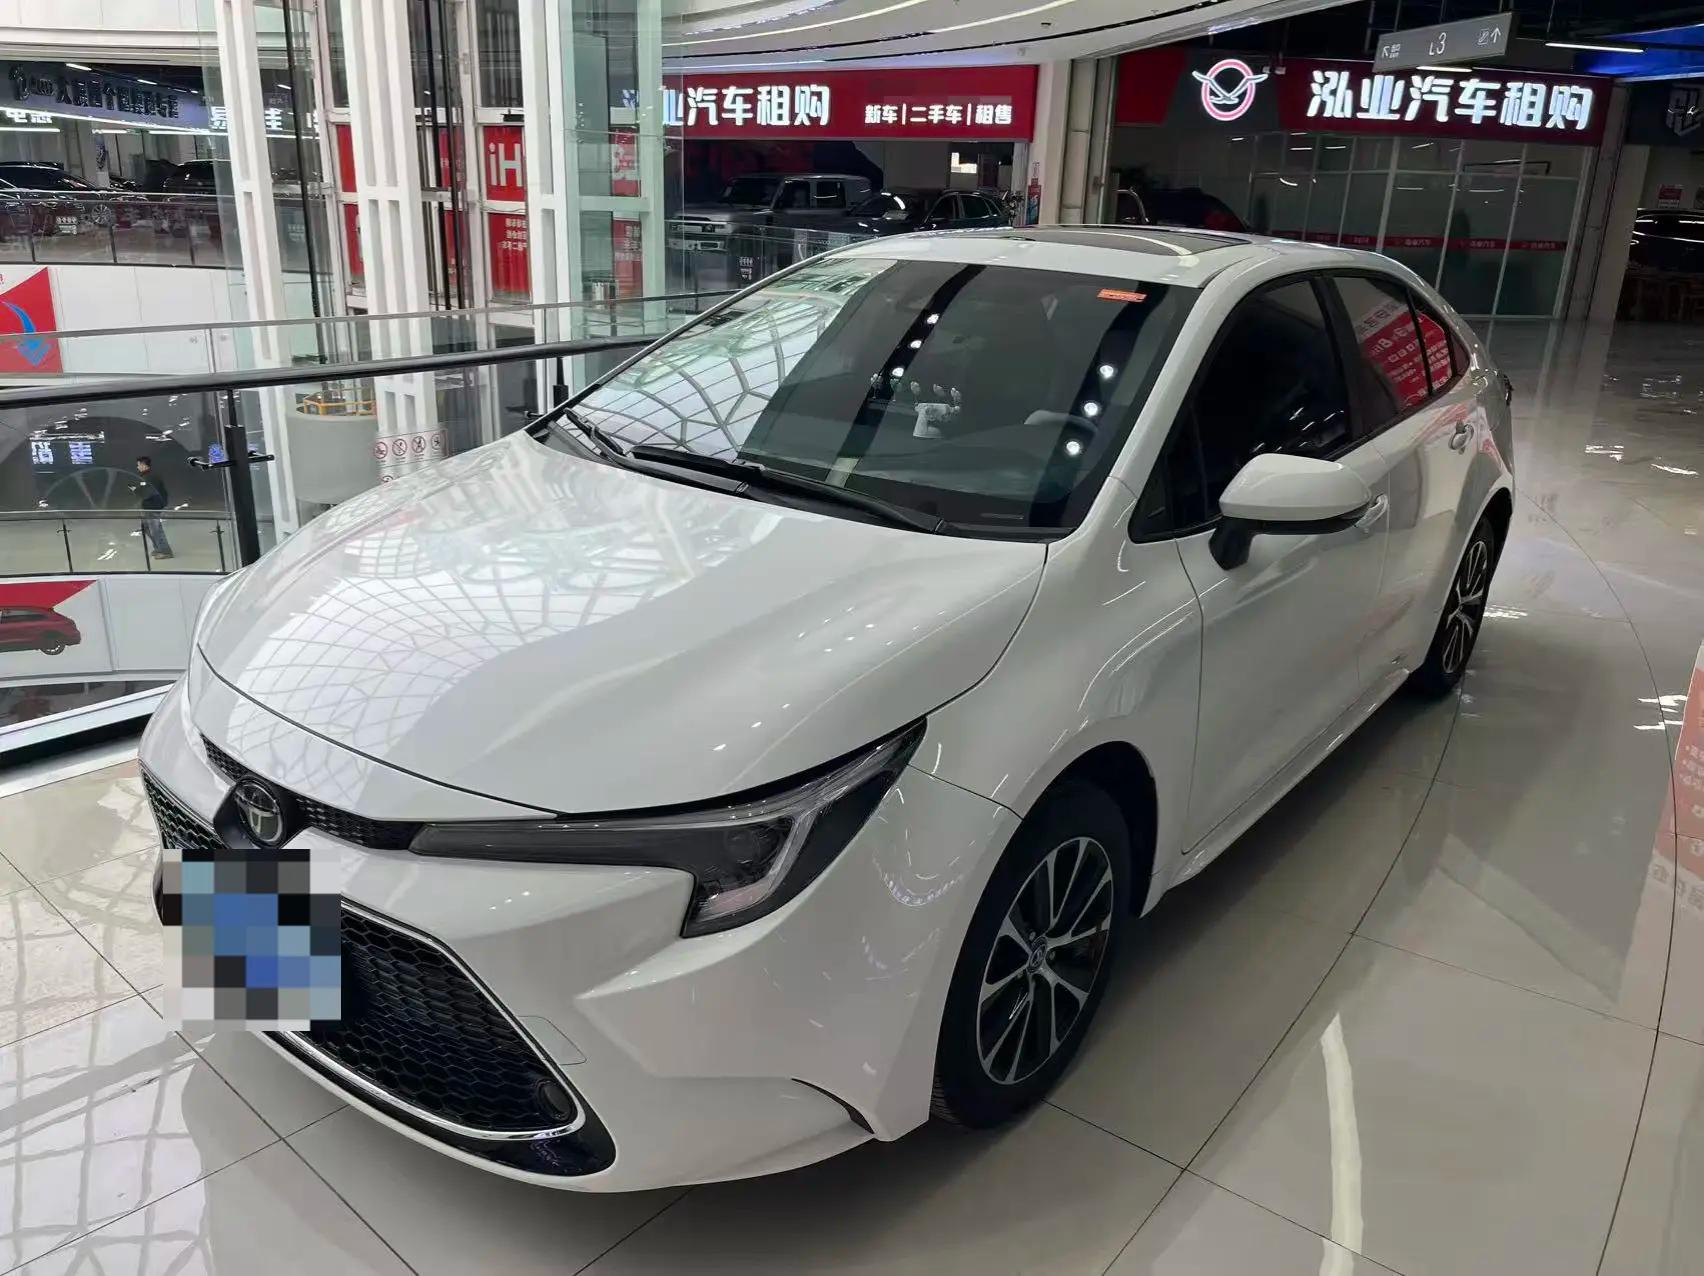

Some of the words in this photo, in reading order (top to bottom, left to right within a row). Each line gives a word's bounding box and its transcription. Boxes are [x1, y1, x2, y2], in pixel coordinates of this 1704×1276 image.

[1429, 32, 1447, 56] L3
[622, 84, 830, 126] 业汽车租购
[1306, 70, 1593, 131] 泓业汽车租购
